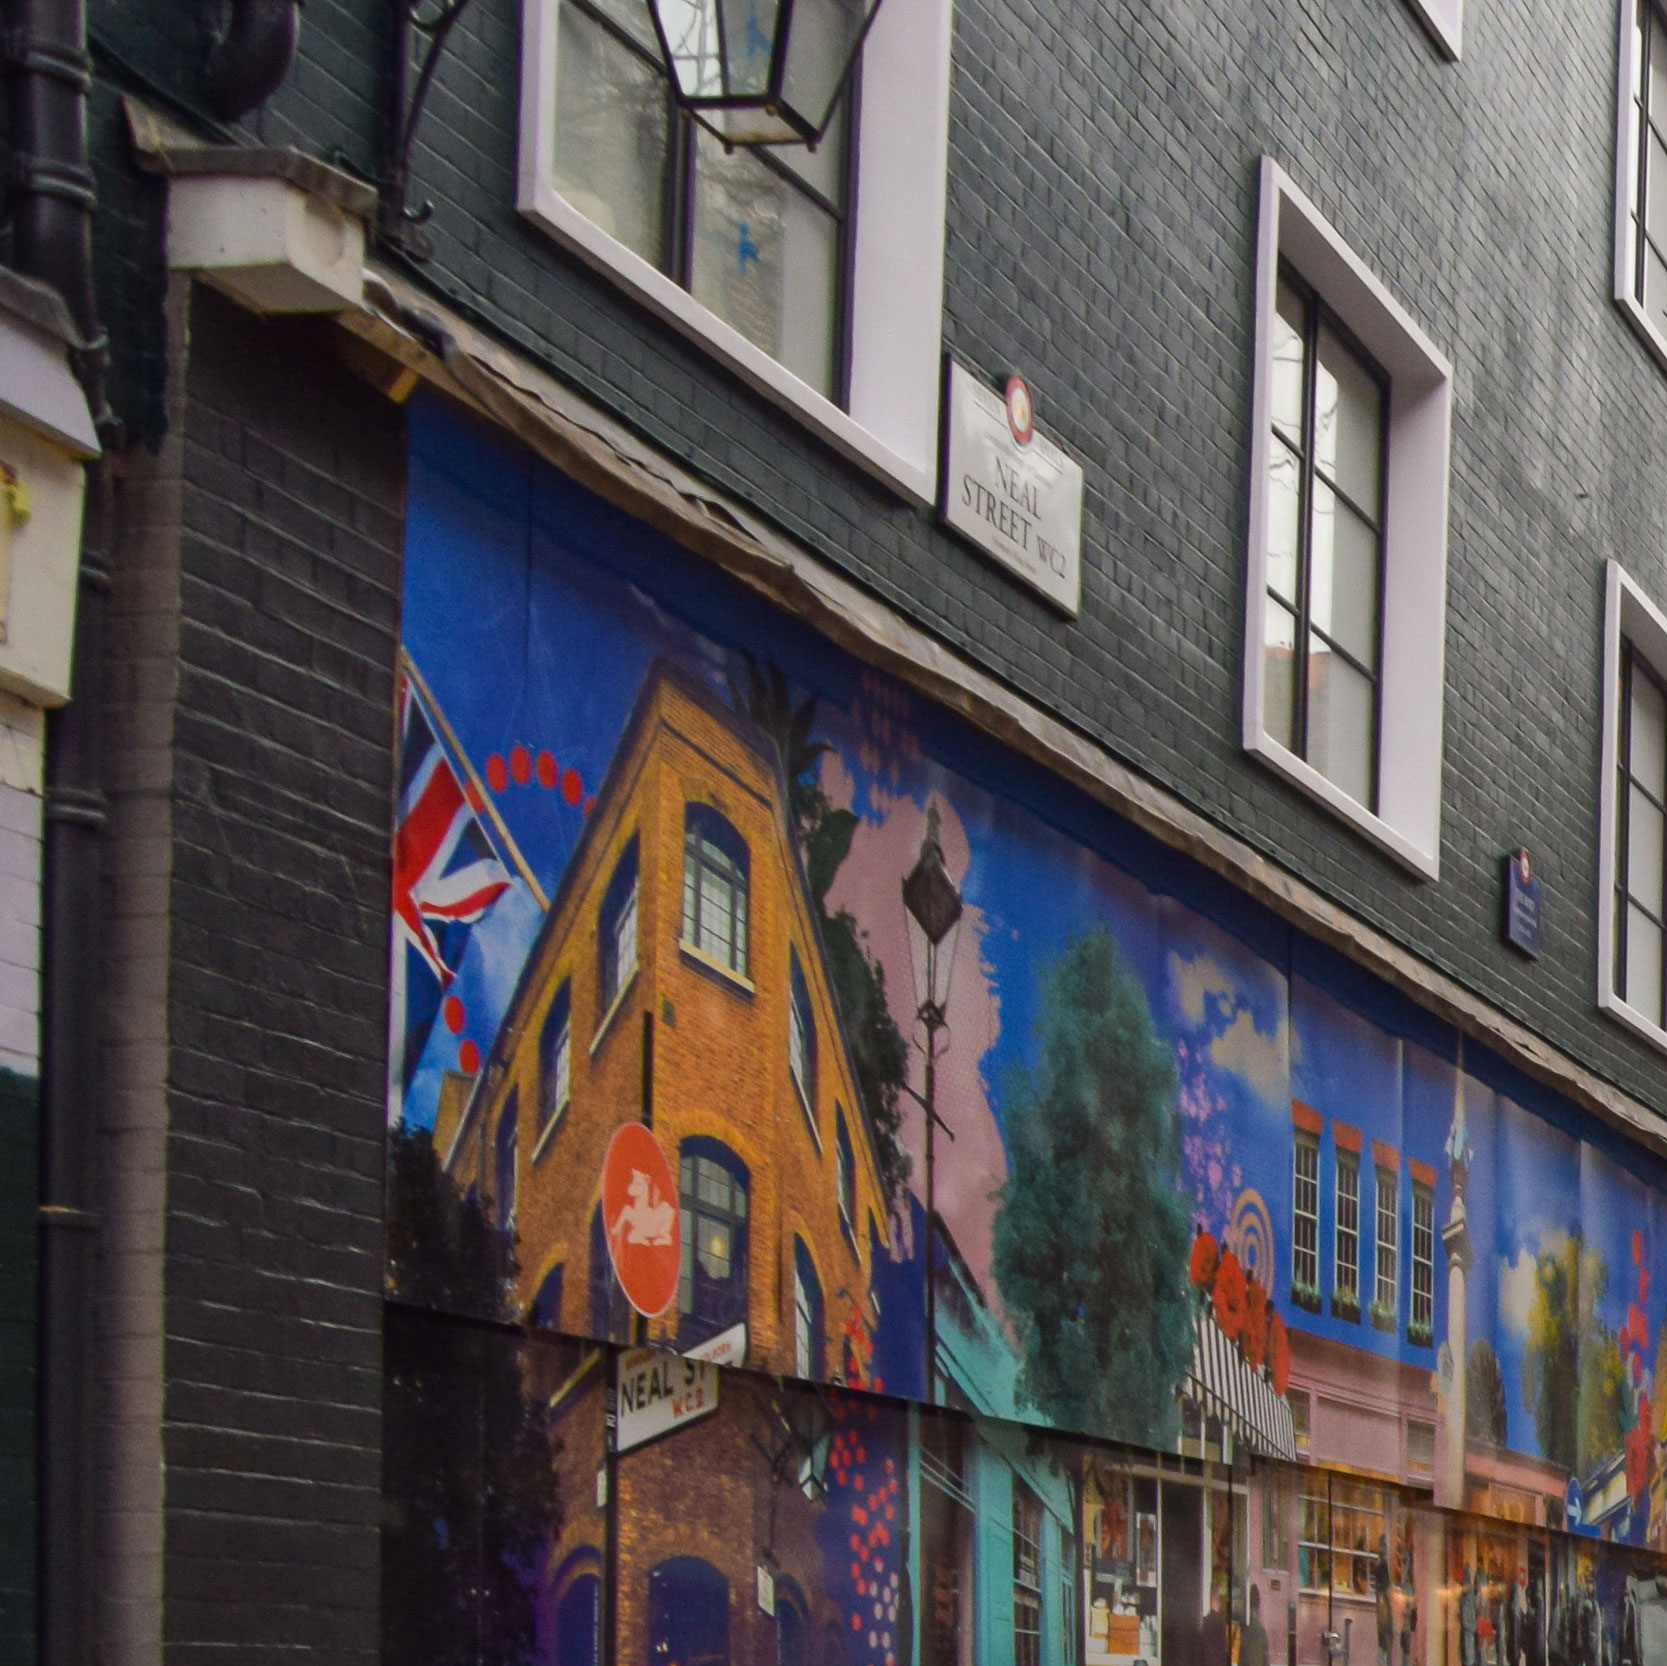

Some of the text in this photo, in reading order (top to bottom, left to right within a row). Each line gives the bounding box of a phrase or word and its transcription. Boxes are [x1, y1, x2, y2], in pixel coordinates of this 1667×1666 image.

[995, 457, 1041, 519] NEAL
[961, 474, 1032, 550] STREET
[1036, 533, 1067, 579] WC2
[621, 1361, 674, 1416] NEAL
